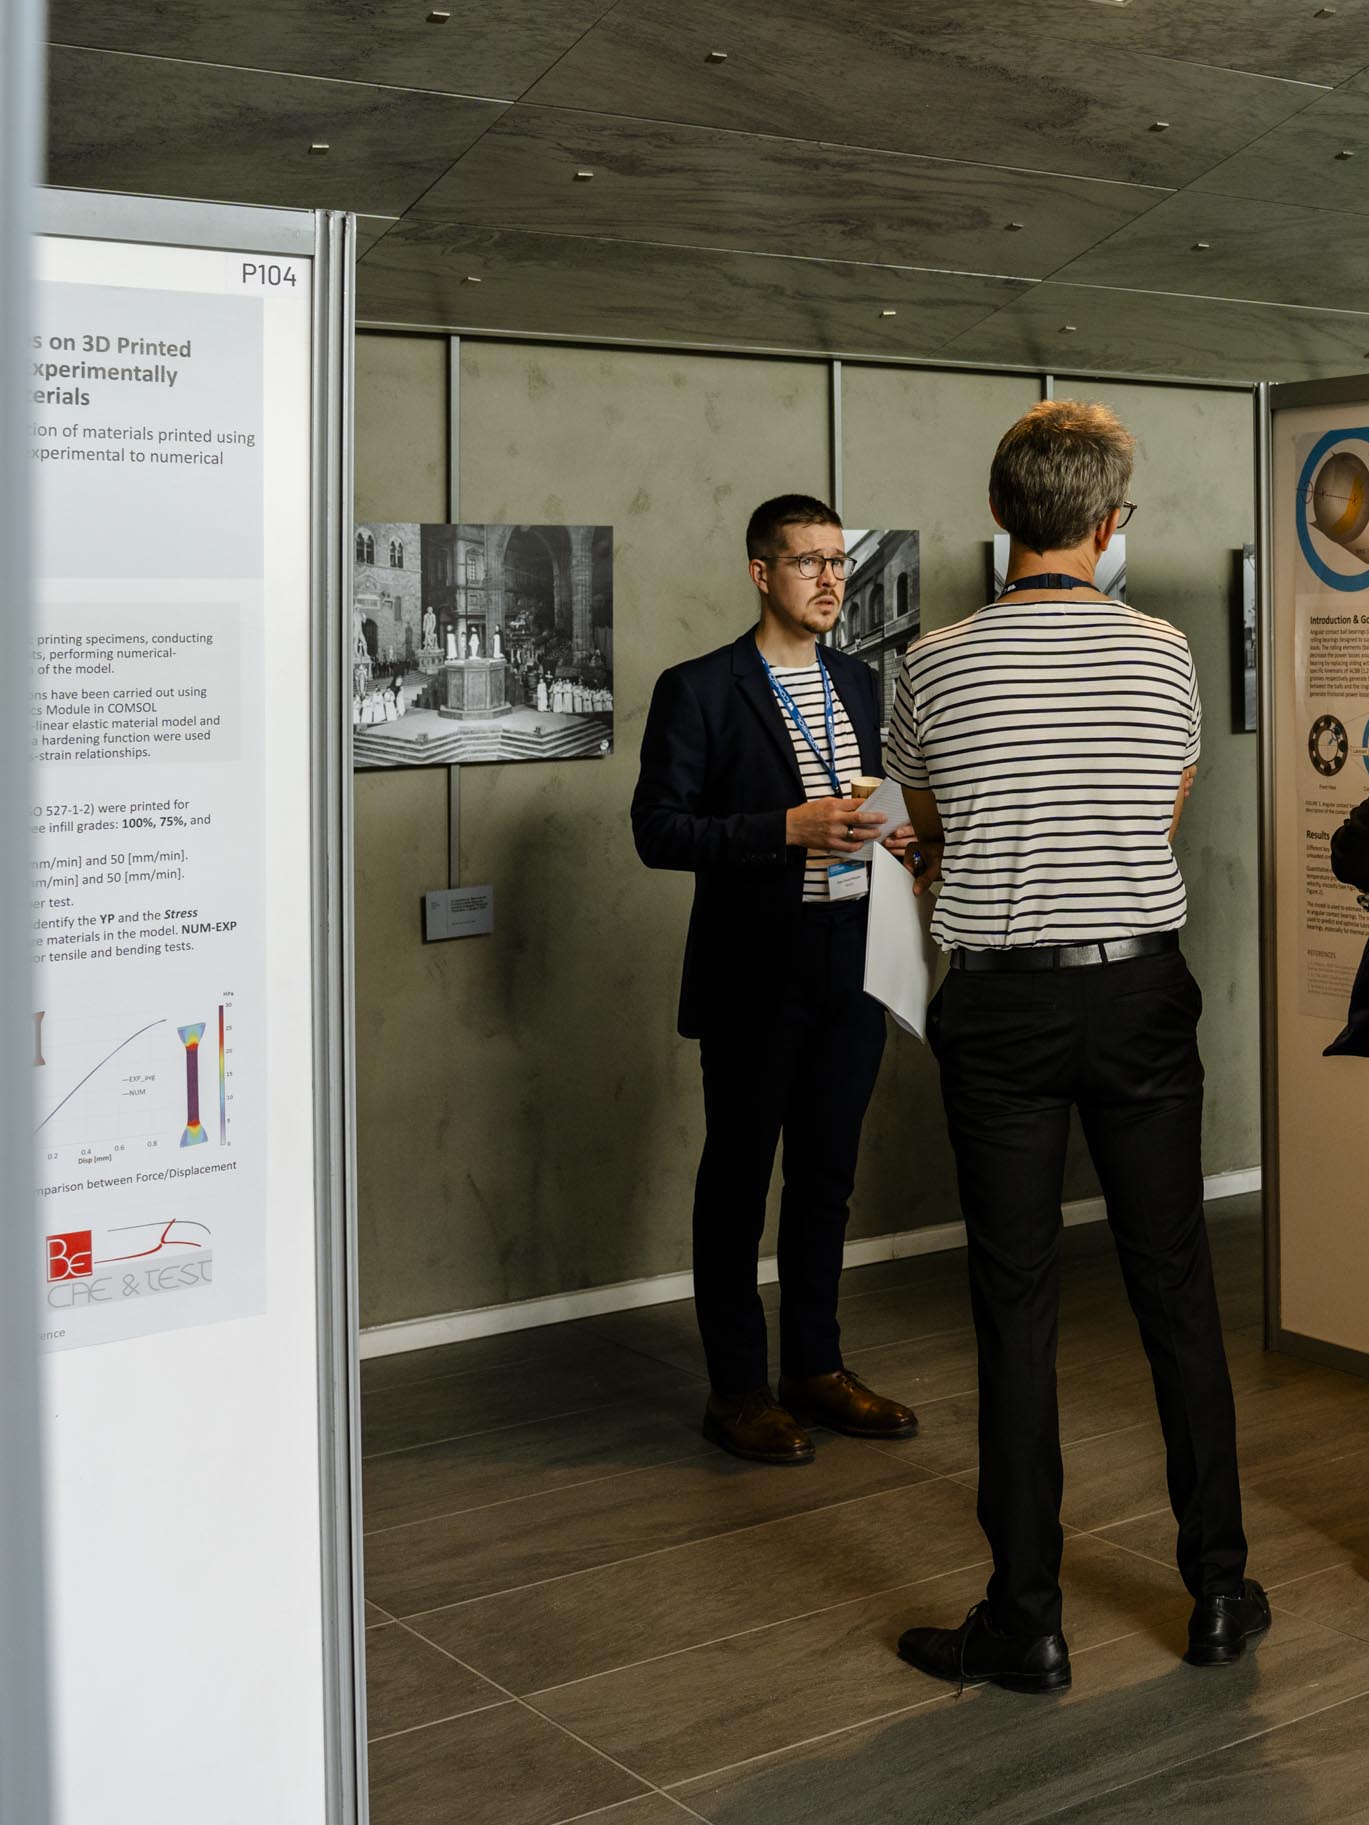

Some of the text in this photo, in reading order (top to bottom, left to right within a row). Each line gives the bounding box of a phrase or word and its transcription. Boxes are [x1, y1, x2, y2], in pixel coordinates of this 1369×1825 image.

[242, 262, 296, 287] P104
[49, 336, 75, 351] on
[82, 334, 110, 352] 3D
[117, 336, 191, 358] Printed
[29, 360, 178, 387] xperimentally
[32, 386, 90, 406] erials
[62, 423, 255, 447] of materials printed using
[28, 445, 223, 464] xperimental to numerical
[1309, 615, 1351, 624] Introduction
[1352, 614, 1359, 624] &
[36, 632, 213, 646] printing specimens, conducting
[49, 647, 176, 662] performing numerical-
[37, 662, 114, 674] of the model.
[46, 702, 157, 715] Module in COMSOL
[49, 813, 210, 833] infill grades: 100%, 75%, and
[1306, 830, 1330, 840] Results
[46, 920, 237, 945] materials in the model. NUM-EXP
[86, 1161, 237, 1189] between Force/Displacement
